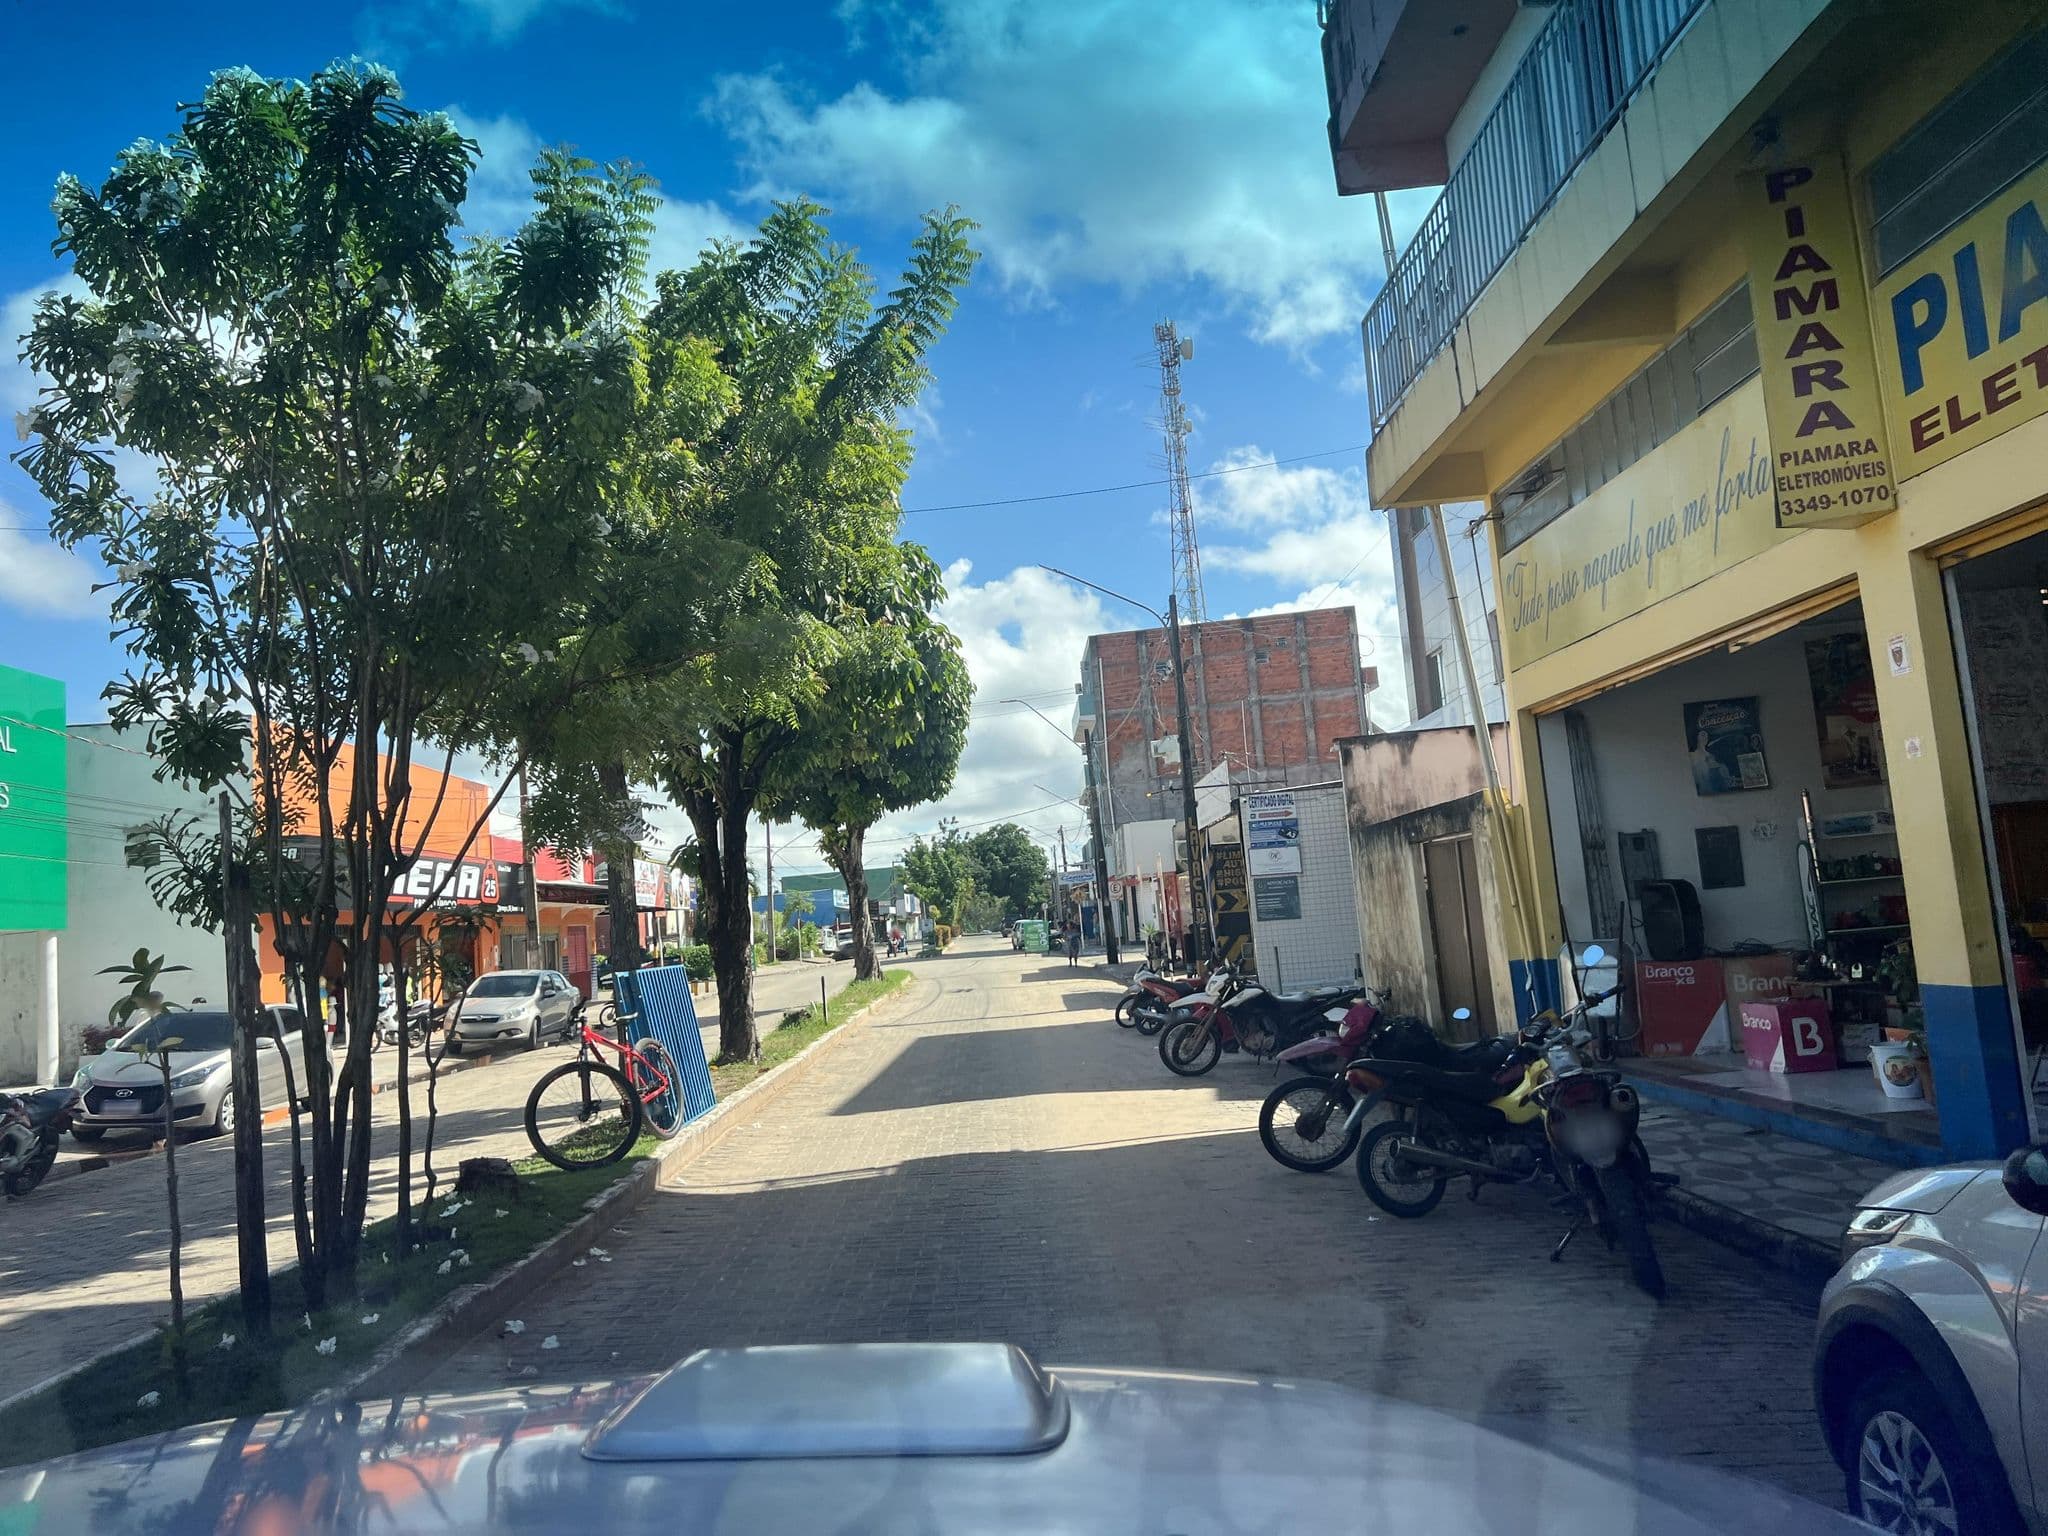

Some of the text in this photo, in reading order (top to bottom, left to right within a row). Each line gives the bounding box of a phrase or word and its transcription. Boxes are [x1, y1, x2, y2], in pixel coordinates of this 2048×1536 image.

[1765, 167, 1855, 438] PIAMARA
[1780, 438, 1878, 468] PIAMARA
[1777, 461, 1886, 492] ELETROMÓVEIS
[1781, 485, 1890, 516] 3349-1070
[1546, 569, 1579, 642] posso
[1583, 498, 1641, 611] naquele
[1646, 513, 1678, 589] que
[1682, 493, 1711, 538] me
[1645, 965, 1694, 978] Branco
[1742, 1012, 1772, 1031] Branco
[1792, 1016, 1825, 1057] B
